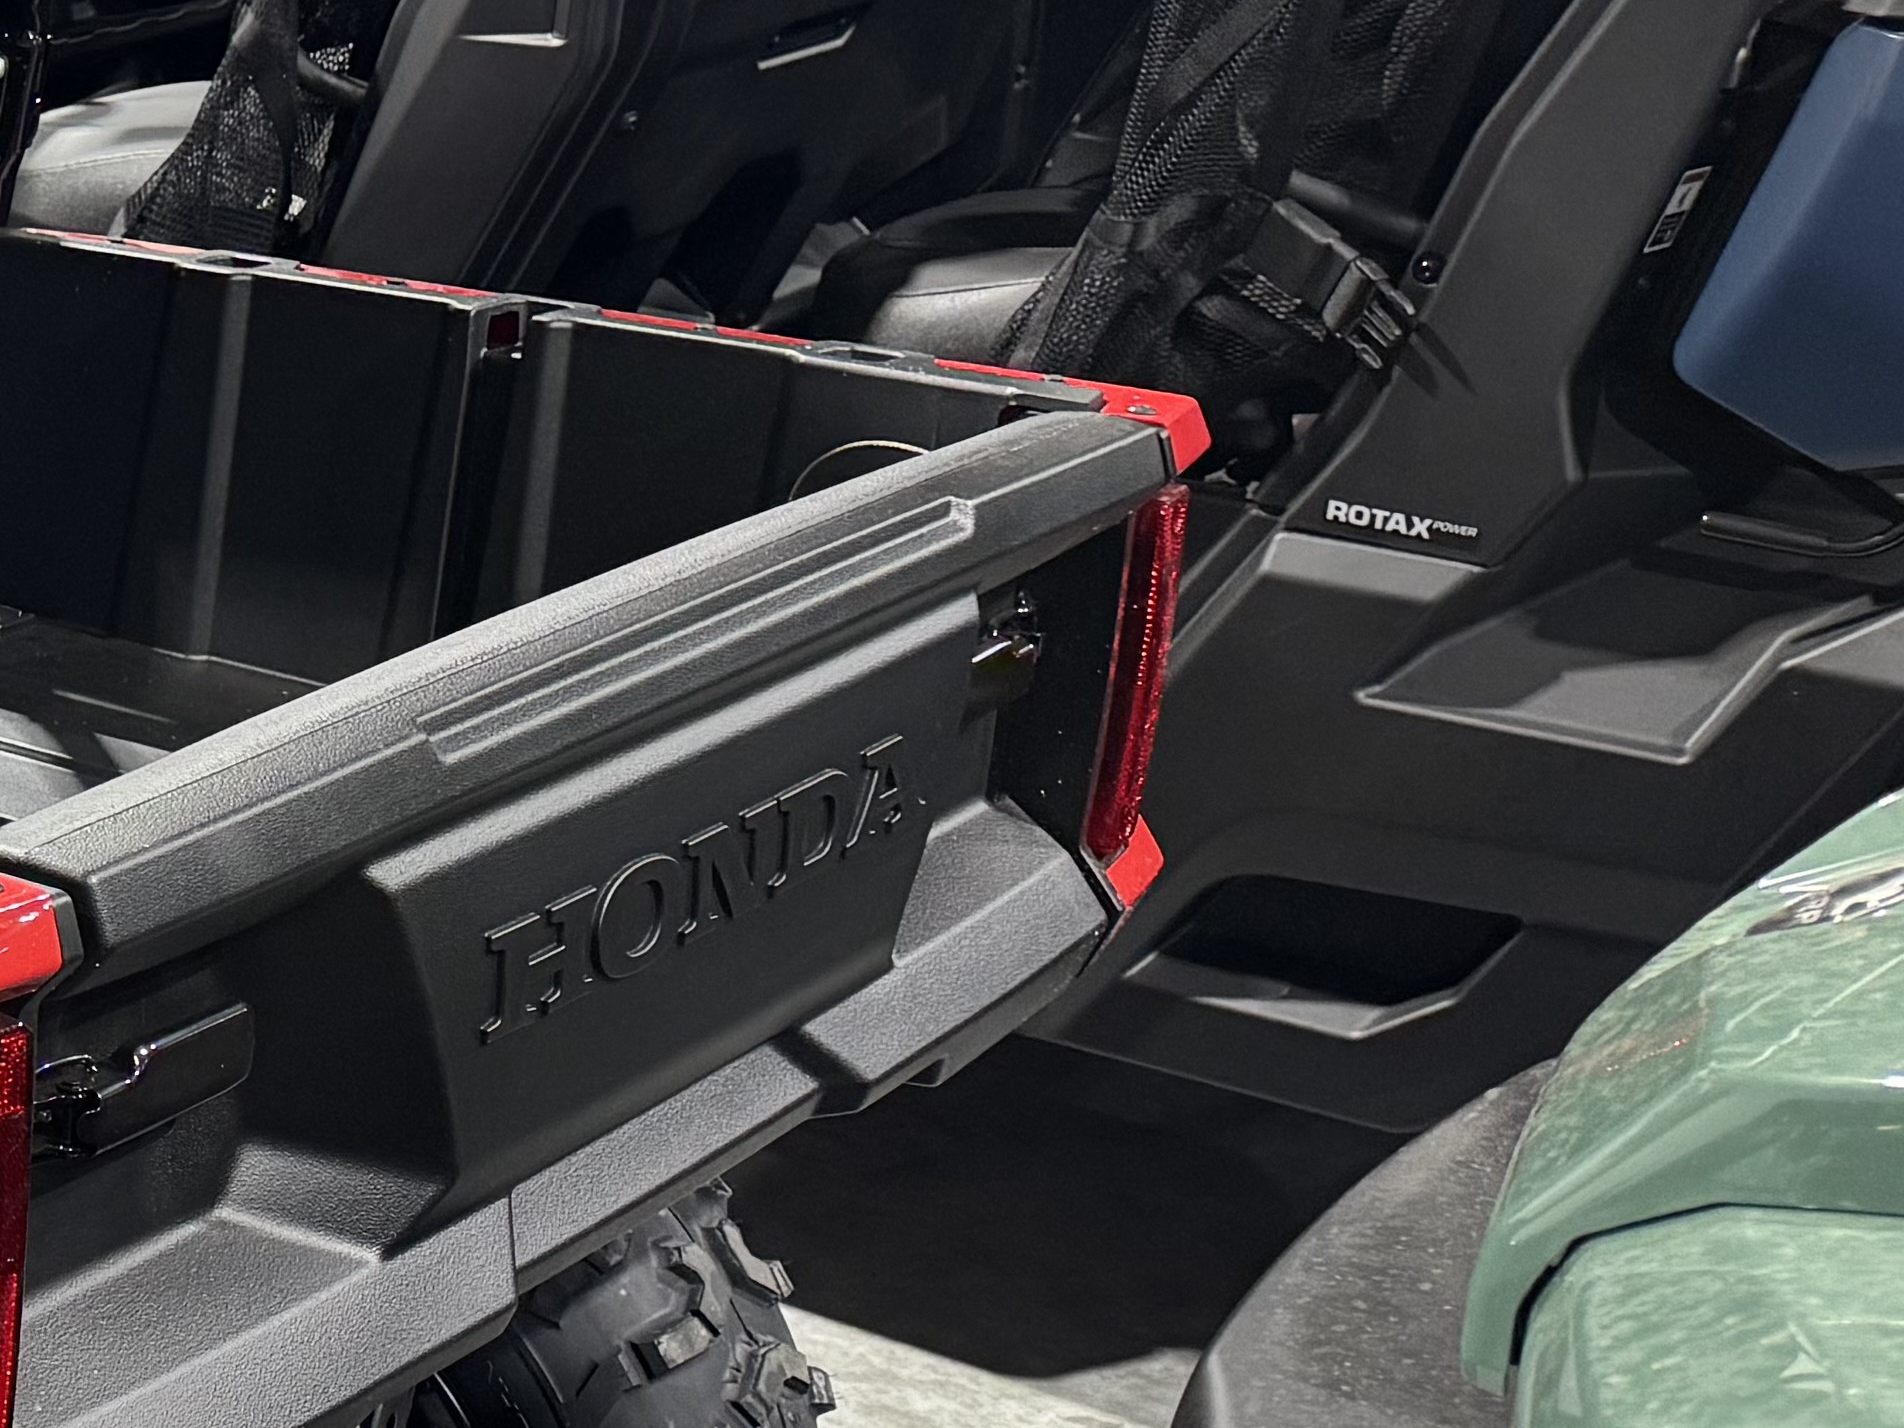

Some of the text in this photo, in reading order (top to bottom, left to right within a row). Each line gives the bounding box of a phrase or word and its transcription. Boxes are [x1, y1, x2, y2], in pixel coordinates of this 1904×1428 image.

[1326, 499, 1479, 540] ROTAX POWER
[480, 735, 926, 1044] HONDA
